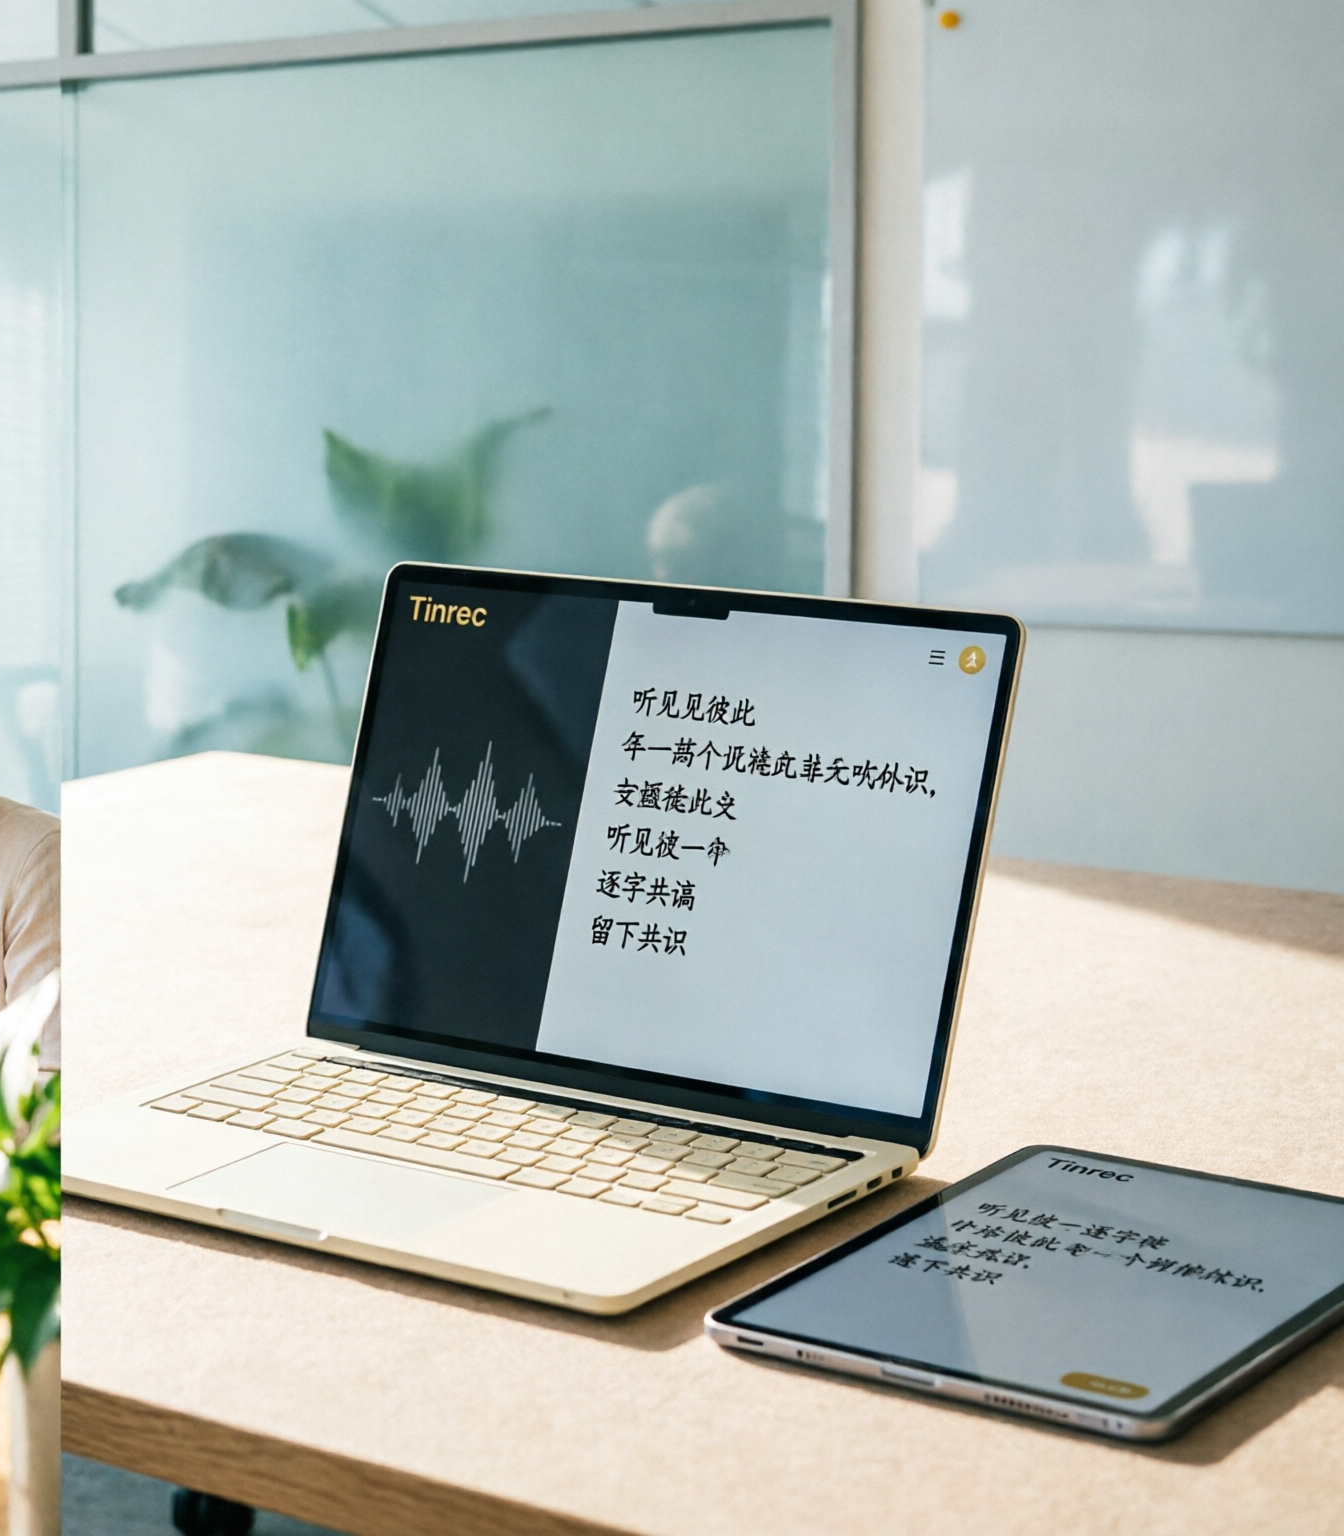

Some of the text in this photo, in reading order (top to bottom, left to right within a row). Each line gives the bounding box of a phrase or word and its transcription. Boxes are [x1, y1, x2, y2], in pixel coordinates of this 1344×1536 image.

[410, 595, 488, 627] Tinrec
[633, 687, 756, 727] 听见见彼此
[591, 915, 688, 956] 留下共识
[1048, 1157, 1135, 1182] Tinrec
